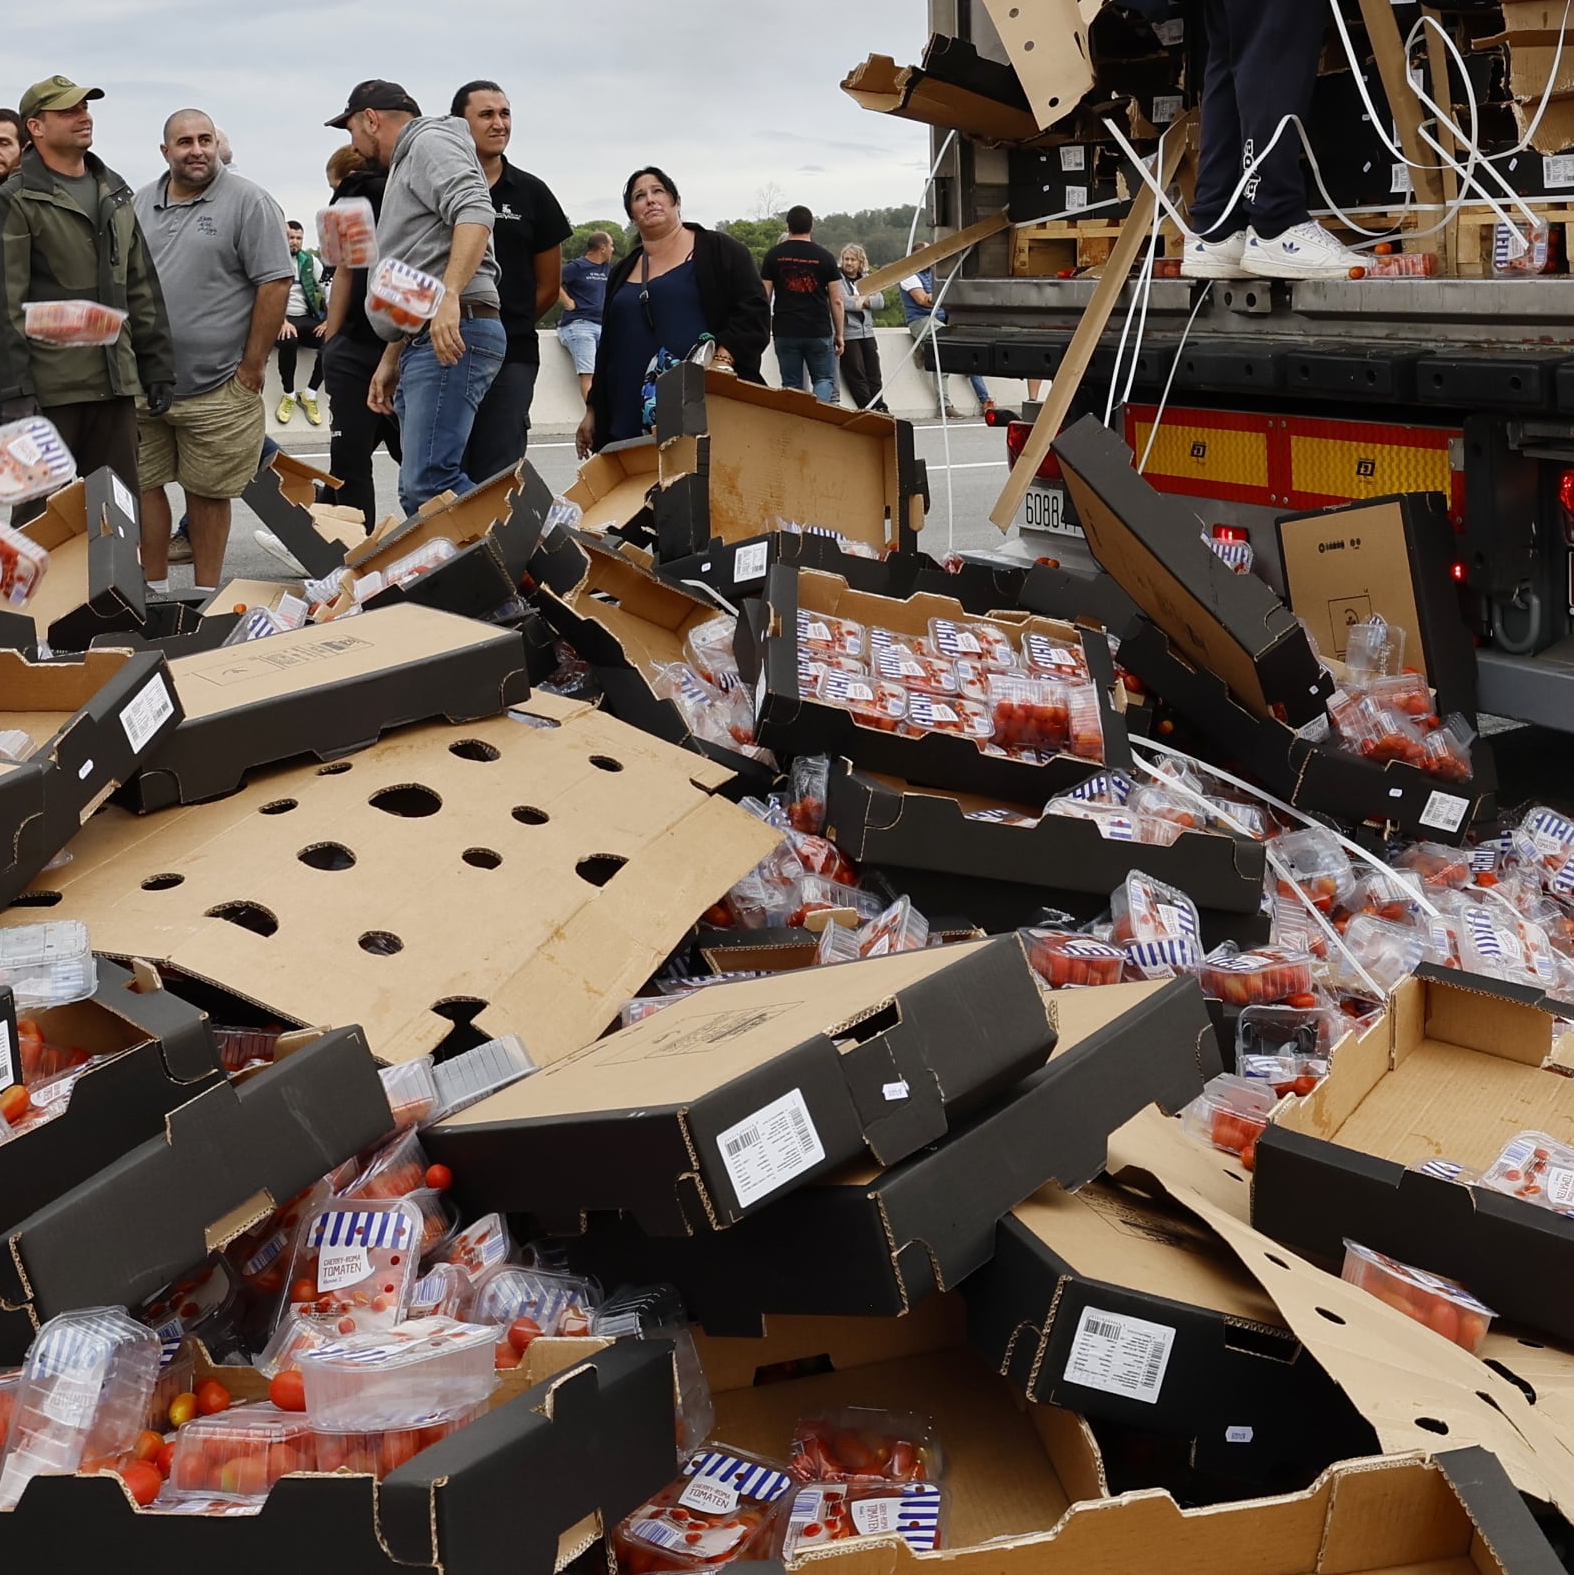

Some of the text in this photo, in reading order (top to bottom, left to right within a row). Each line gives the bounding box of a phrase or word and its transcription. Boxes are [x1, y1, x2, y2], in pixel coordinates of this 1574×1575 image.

[1557, 1175, 1572, 1201] TOMATEN
[322, 1262, 362, 1277] TOMATEN
[323, 1255, 361, 1267] CHERRY-ROMA
[689, 1488, 730, 1509] TOMATEN
[692, 1483, 731, 1499] CHERRY-ROMA
[867, 1505, 877, 1533] TOMATEN
